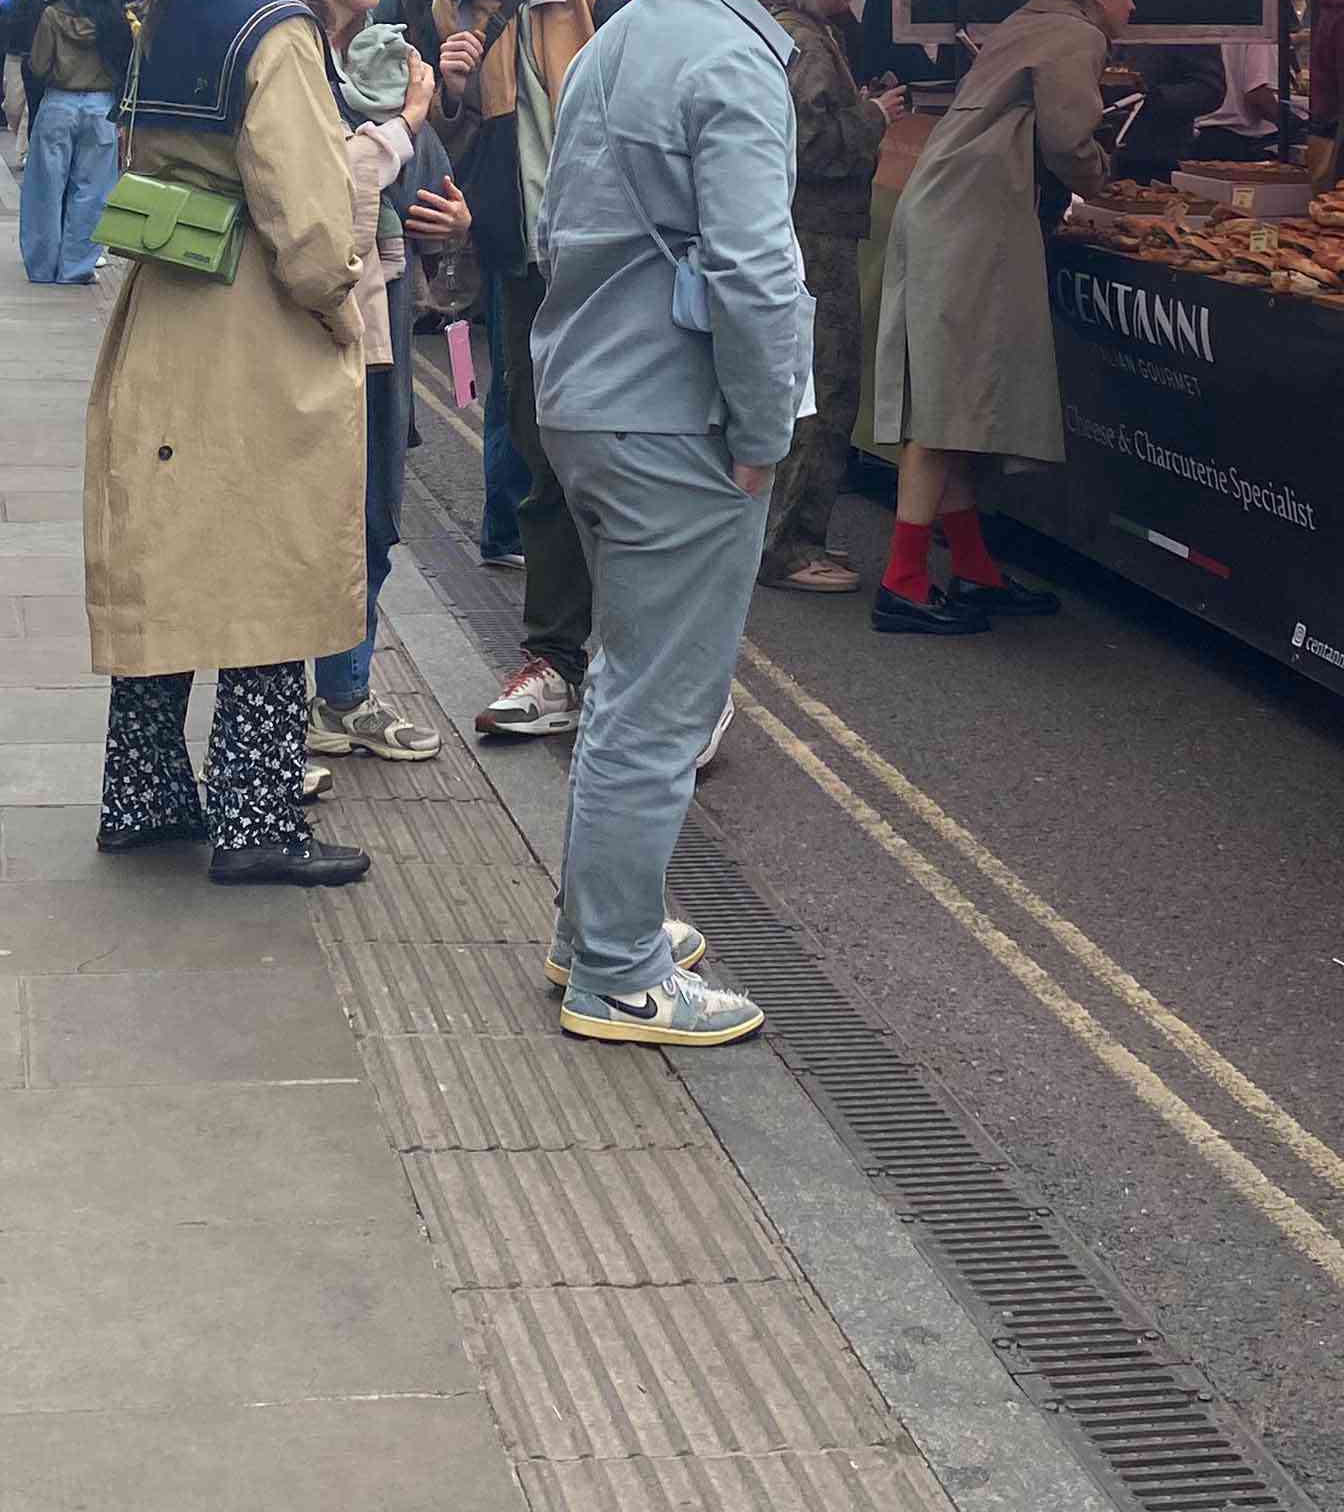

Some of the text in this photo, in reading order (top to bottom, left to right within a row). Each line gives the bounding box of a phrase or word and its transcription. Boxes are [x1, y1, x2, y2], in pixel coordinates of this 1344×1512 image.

[1056, 267, 1215, 364] CENTANNI
[1132, 428, 1230, 496] Charcuterie
[1229, 466, 1317, 531] Specialist
